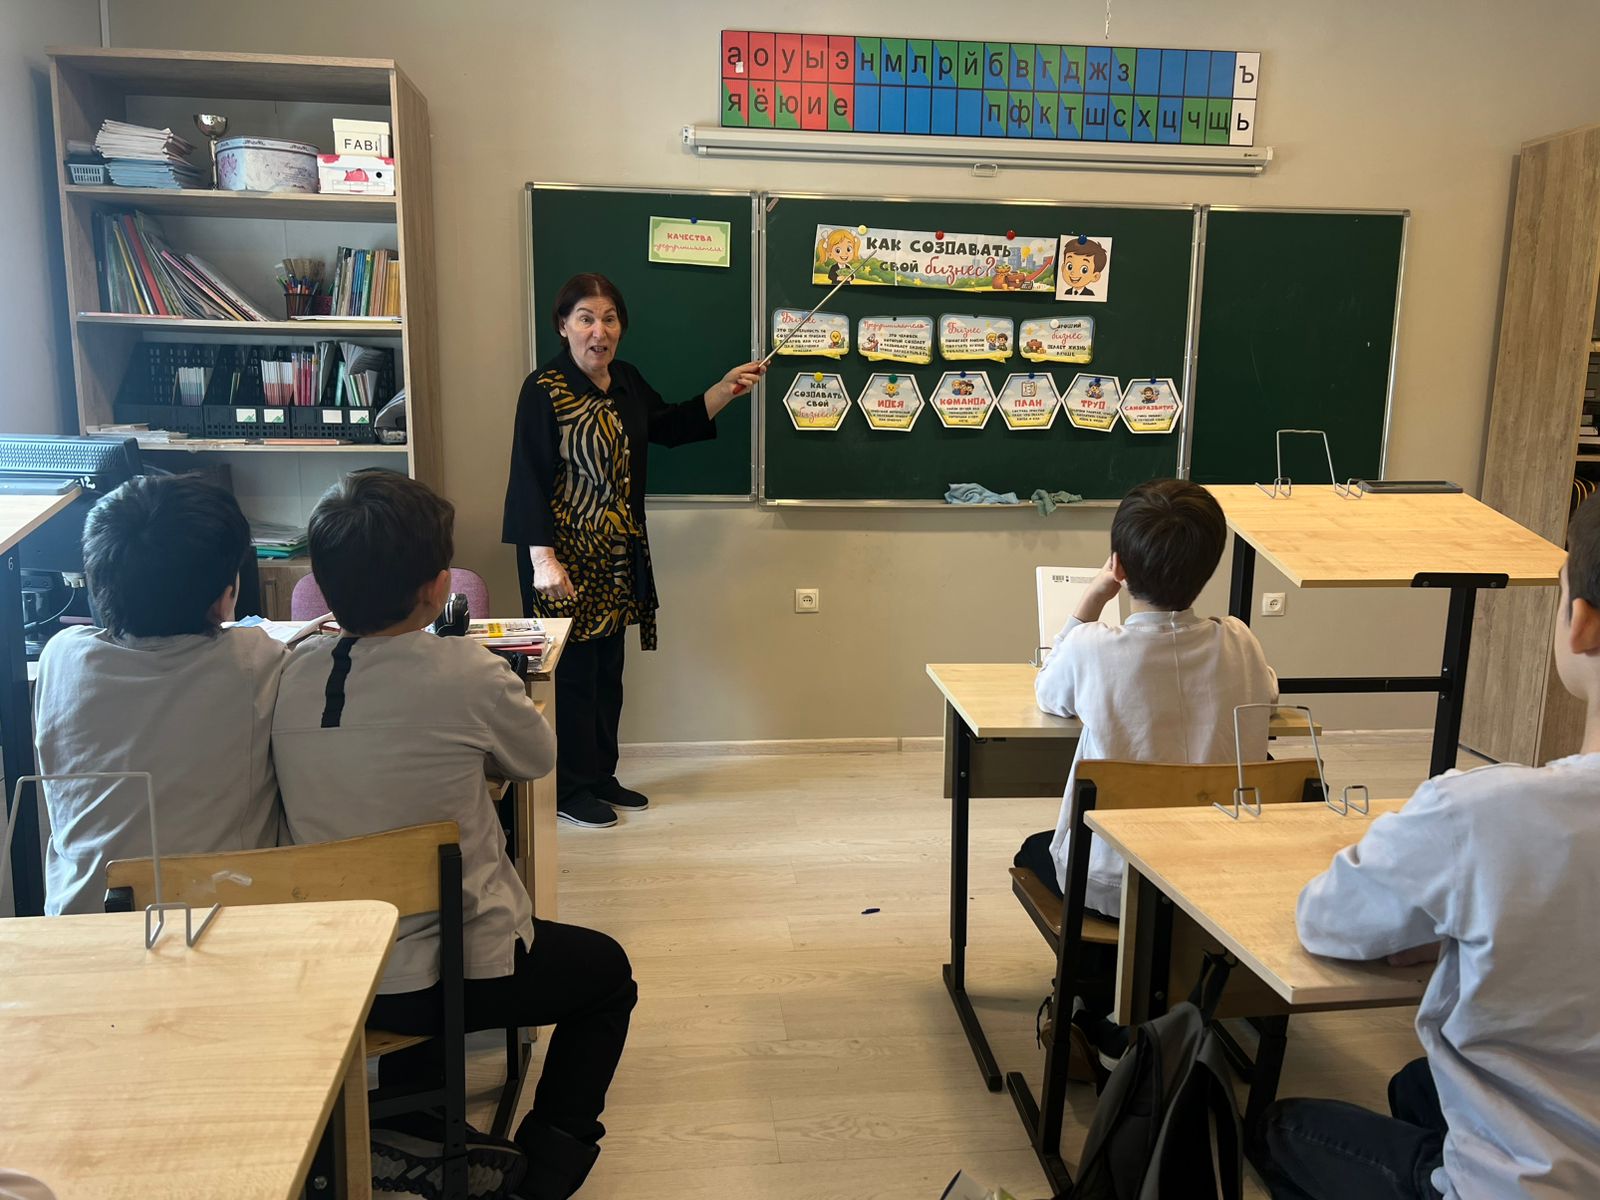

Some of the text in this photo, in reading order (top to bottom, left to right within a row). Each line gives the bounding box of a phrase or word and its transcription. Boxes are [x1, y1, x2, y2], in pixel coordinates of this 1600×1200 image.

[728, 47, 1254, 84] а о у ы э н м л р й б в г д ж з ъ
[728, 87, 1249, 134] я ё ю и е п ф к т ш с х ц ч щ ь
[344, 138, 378, 151] FABI
[667, 232, 712, 242] КАЧЕСТВА
[866, 237, 1011, 257] КАК СОЗДАВАТЬ
[879, 256, 996, 286] СВОЙ бизнес?
[948, 322, 982, 338] Бизнес
[1051, 329, 1083, 345] бизнес
[794, 391, 842, 399] СОЗДАВАТЬ
[878, 399, 904, 408] ИДЕЯ
[1081, 400, 1106, 409] ТРУД
